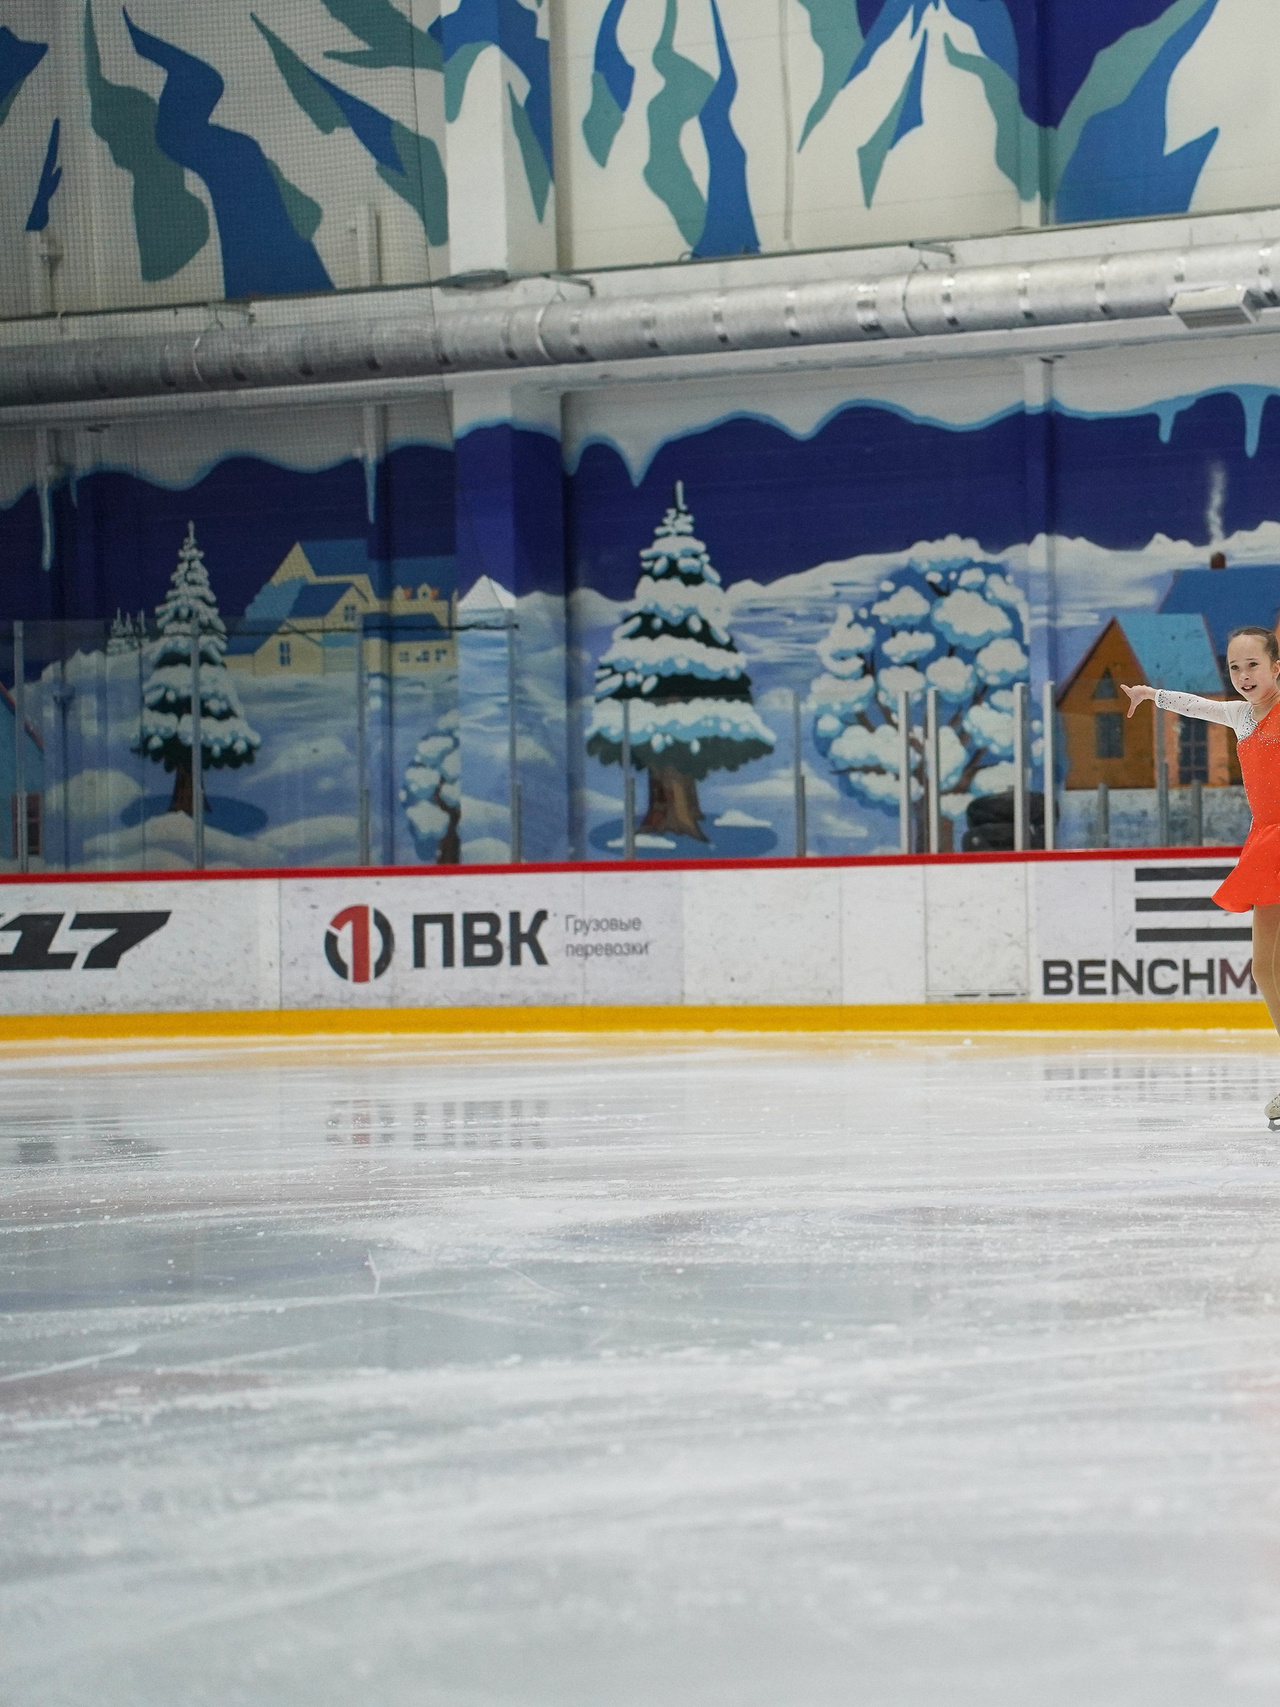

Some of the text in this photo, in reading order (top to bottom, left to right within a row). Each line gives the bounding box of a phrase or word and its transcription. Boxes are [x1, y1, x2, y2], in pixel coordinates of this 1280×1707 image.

[0, 910, 172, 971] 17
[412, 909, 549, 968] ПВК
[565, 914, 642, 935] Грузовые
[566, 942, 650, 960] перевозки
